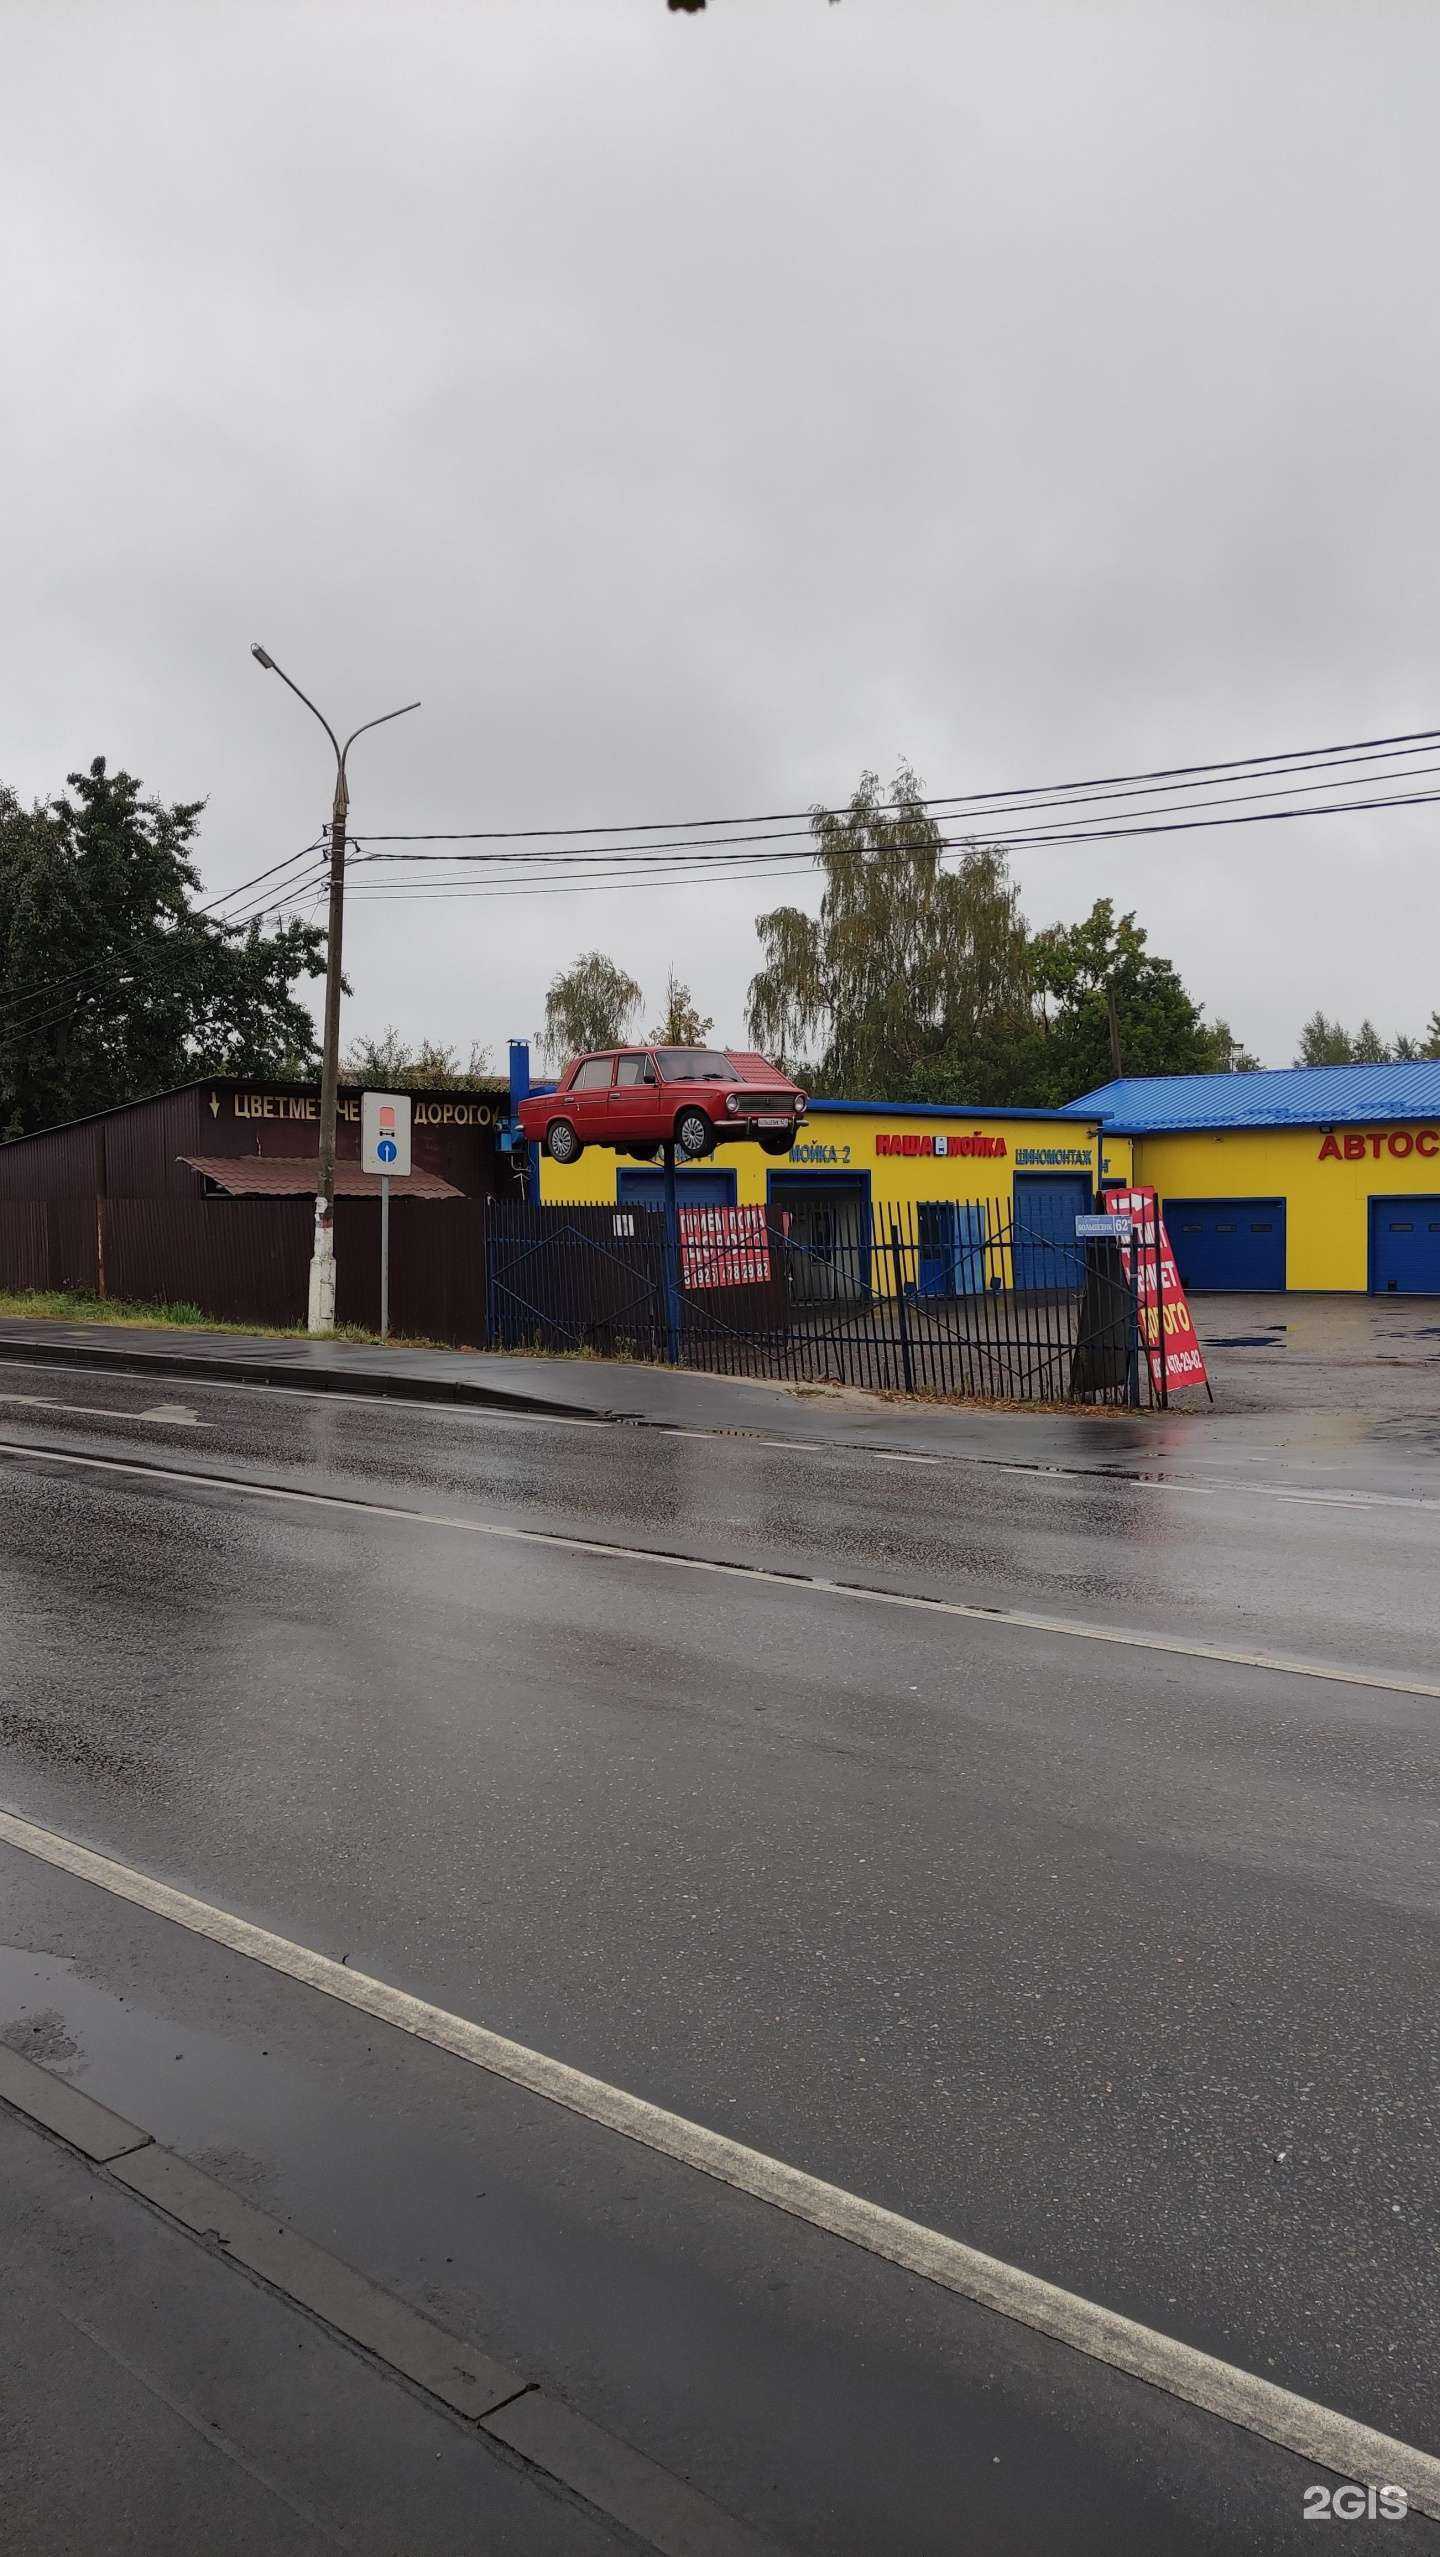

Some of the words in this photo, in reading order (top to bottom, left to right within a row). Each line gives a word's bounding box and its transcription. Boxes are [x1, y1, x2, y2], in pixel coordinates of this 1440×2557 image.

[234, 1093, 321, 1120] ЦВЕТМЕ
[789, 1139, 837, 1164] МОЙКА
[841, 1144, 851, 1164] 2
[875, 1134, 933, 1157] НАША
[947, 1130, 1008, 1158] МОЙКА
[1015, 1148, 1092, 1166] ШИНОМОНТАЖ
